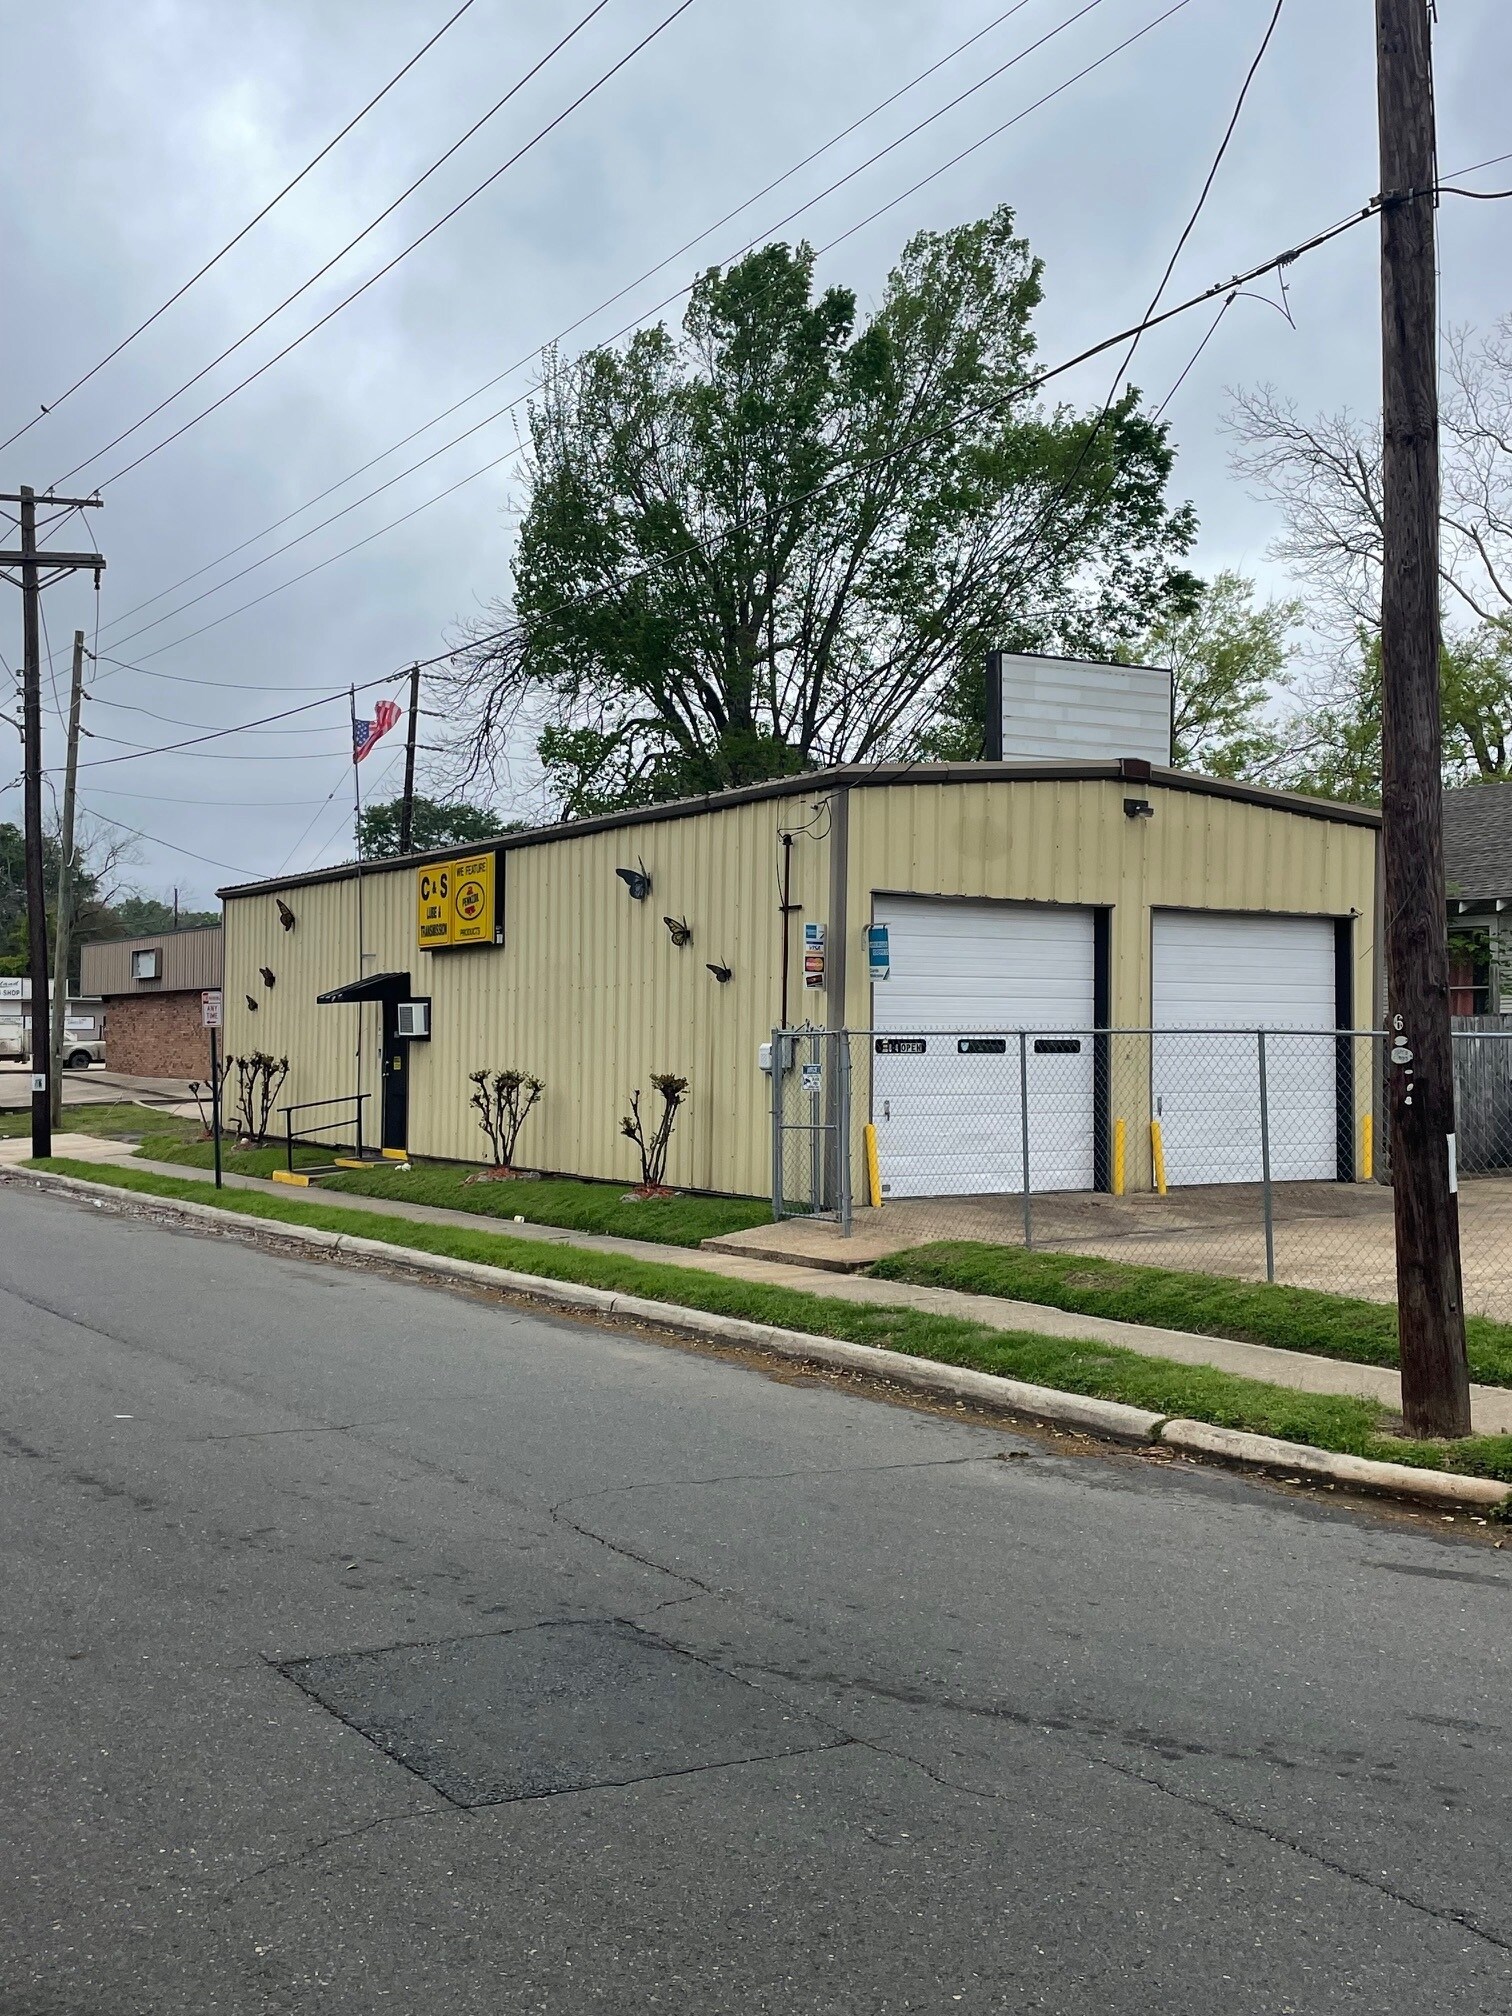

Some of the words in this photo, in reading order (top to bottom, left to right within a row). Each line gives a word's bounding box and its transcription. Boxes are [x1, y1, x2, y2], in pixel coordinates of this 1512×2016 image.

[457, 867, 464, 877] WE
[466, 862, 486, 876] FEATURE
[421, 876, 430, 901] C
[432, 881, 437, 894] &
[440, 873, 448, 899] S
[421, 923, 447, 937] TRANSMISSION
[460, 927, 480, 937] PRODUCTS
[1393, 1014, 1404, 1031] 6
[901, 1043, 921, 1052] OPEN
